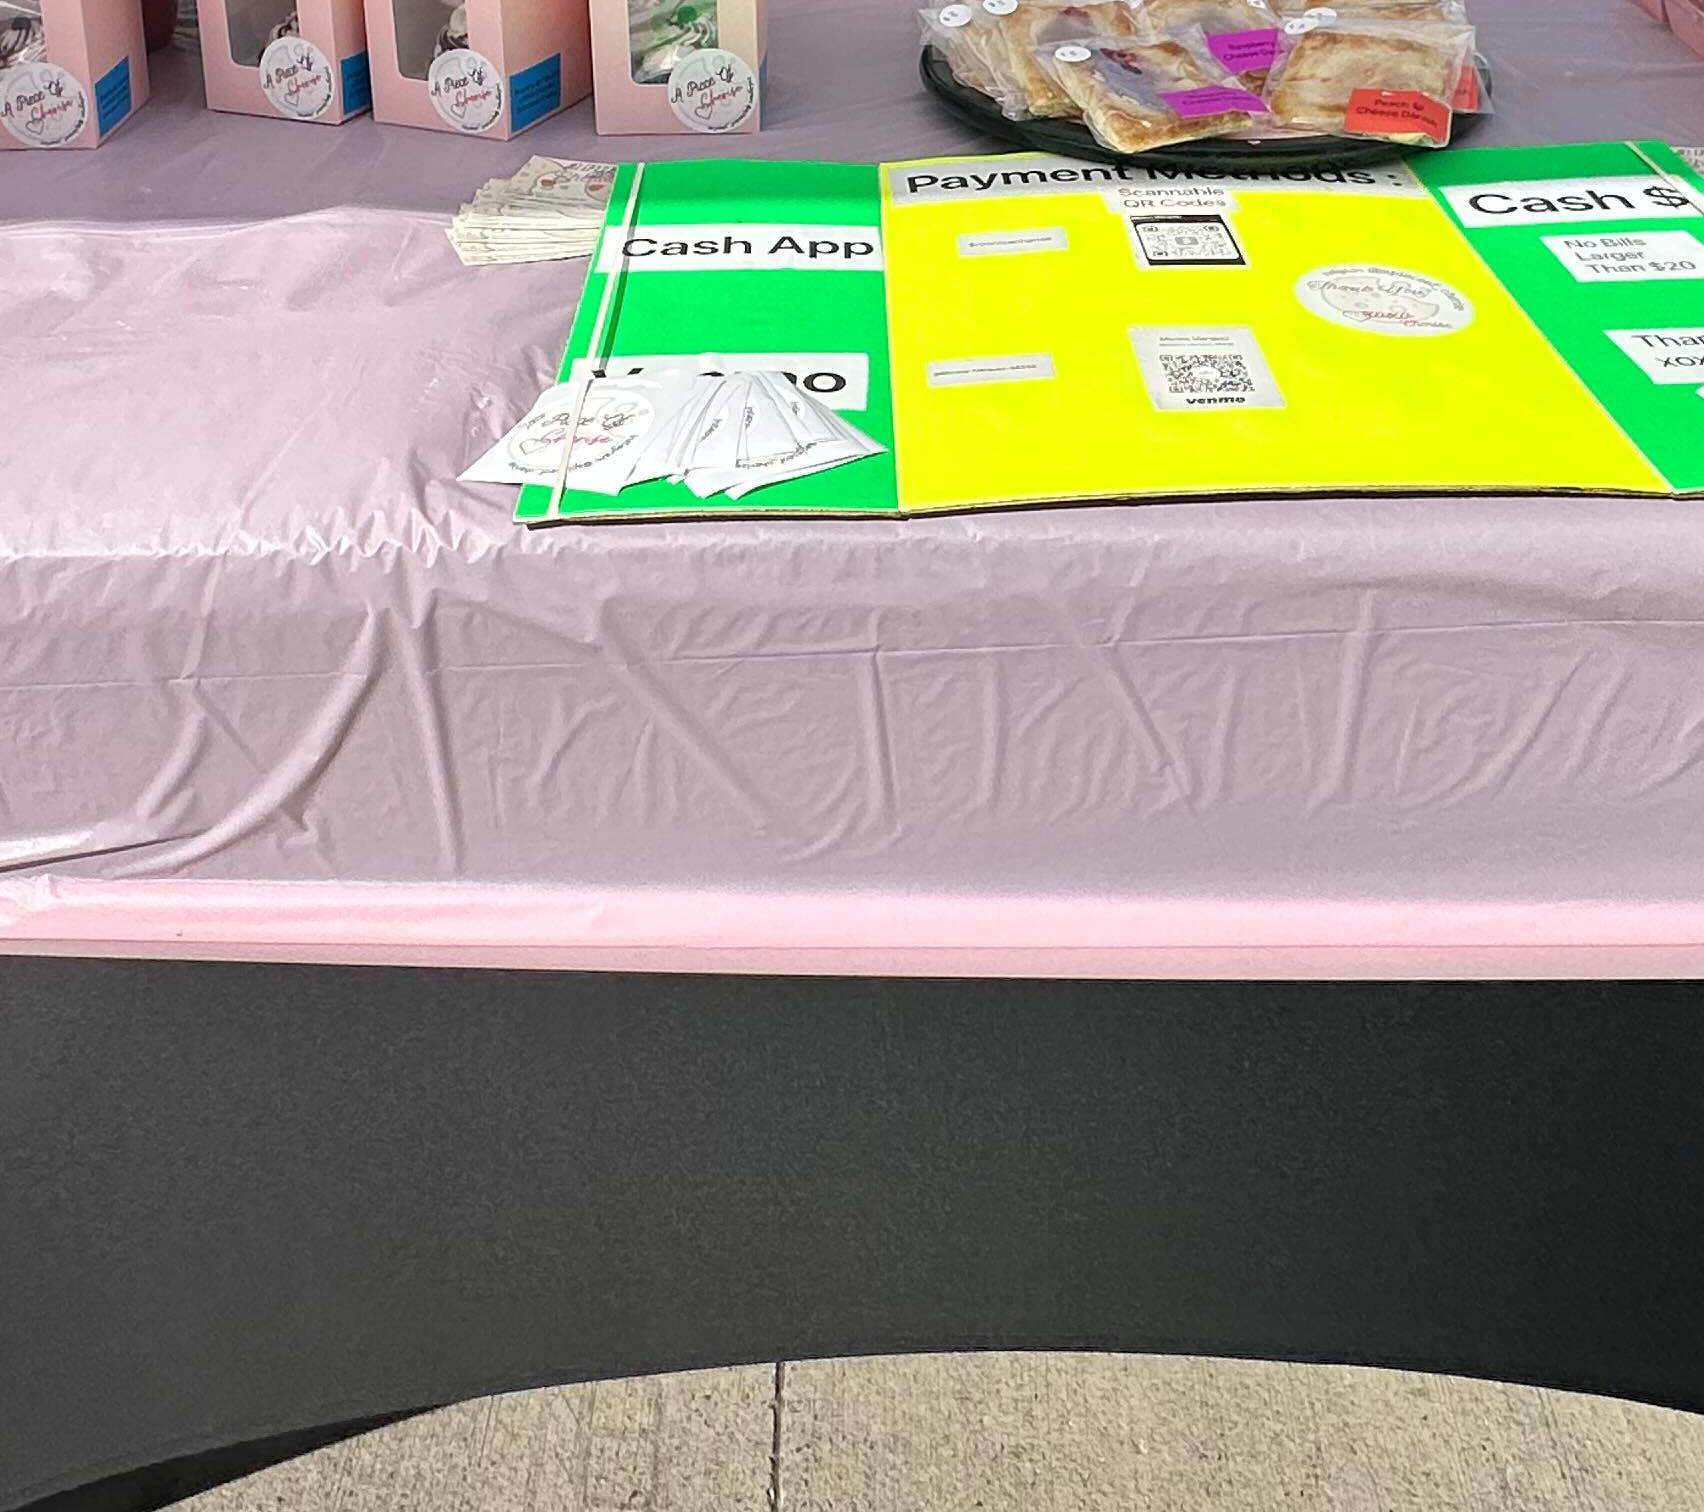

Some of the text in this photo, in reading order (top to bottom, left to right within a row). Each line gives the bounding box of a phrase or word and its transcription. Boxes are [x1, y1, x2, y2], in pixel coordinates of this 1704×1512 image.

[907, 165, 1134, 193] Payment
[1118, 187, 1225, 196] Scannable
[1124, 199, 1227, 208] QR Codes
[1469, 186, 1691, 214] Cash $
[622, 236, 874, 259] Cash App
[1564, 237, 1647, 249] No Bills
[1574, 251, 1645, 262] Larger
[1584, 261, 1697, 274] Than $20
